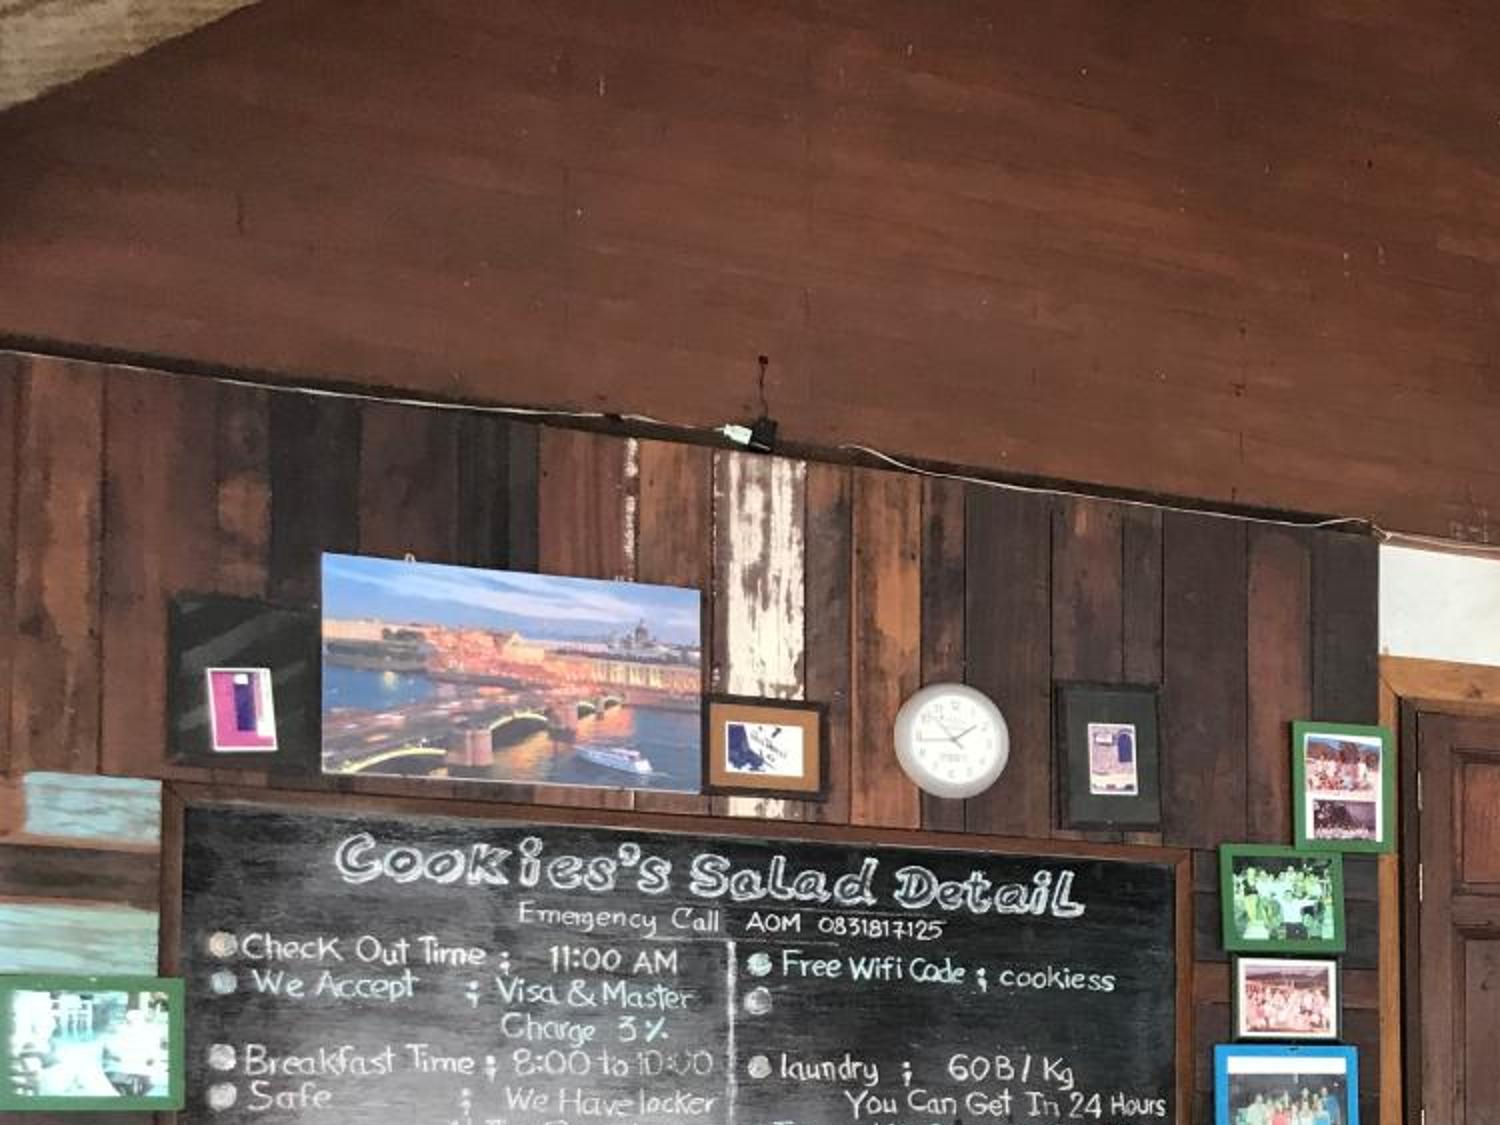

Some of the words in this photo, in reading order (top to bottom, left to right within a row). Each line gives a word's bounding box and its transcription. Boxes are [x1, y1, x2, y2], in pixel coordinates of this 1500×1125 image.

[690, 853, 880, 907] Salad
[518, 900, 657, 939] Emergency
[671, 906, 720, 932] Call
[745, 911, 801, 933] AOM
[817, 915, 948, 941] 0831817125
[355, 935, 411, 966] Out
[417, 935, 487, 967] Time
[549, 945, 623, 974] 11:00
[632, 949, 679, 974] AM
[781, 949, 842, 978] Free
[848, 957, 903, 982] Wifi
[909, 957, 966, 984] Code
[1000, 965, 1116, 992] cookiess
[251, 969, 306, 997] We
[315, 968, 421, 1003] Accept
[495, 976, 561, 1007] Visa
[566, 979, 599, 1008] &
[602, 979, 696, 1011] Master
[500, 1012, 598, 1049] Charge
[245, 1044, 397, 1077] Breakfast
[404, 1044, 475, 1077] Time
[512, 1048, 591, 1077] 8:00
[595, 1048, 630, 1078] to
[246, 1081, 333, 1111] Safe
[504, 1086, 550, 1113] We
[558, 1086, 635, 1117] Have
[843, 1090, 899, 1119] You
[906, 1088, 958, 1117] Can
[965, 1089, 1013, 1117] Get
[1025, 1091, 1061, 1117] In
[1067, 1093, 1103, 1119] 24
[1109, 1094, 1168, 1118] Hours
